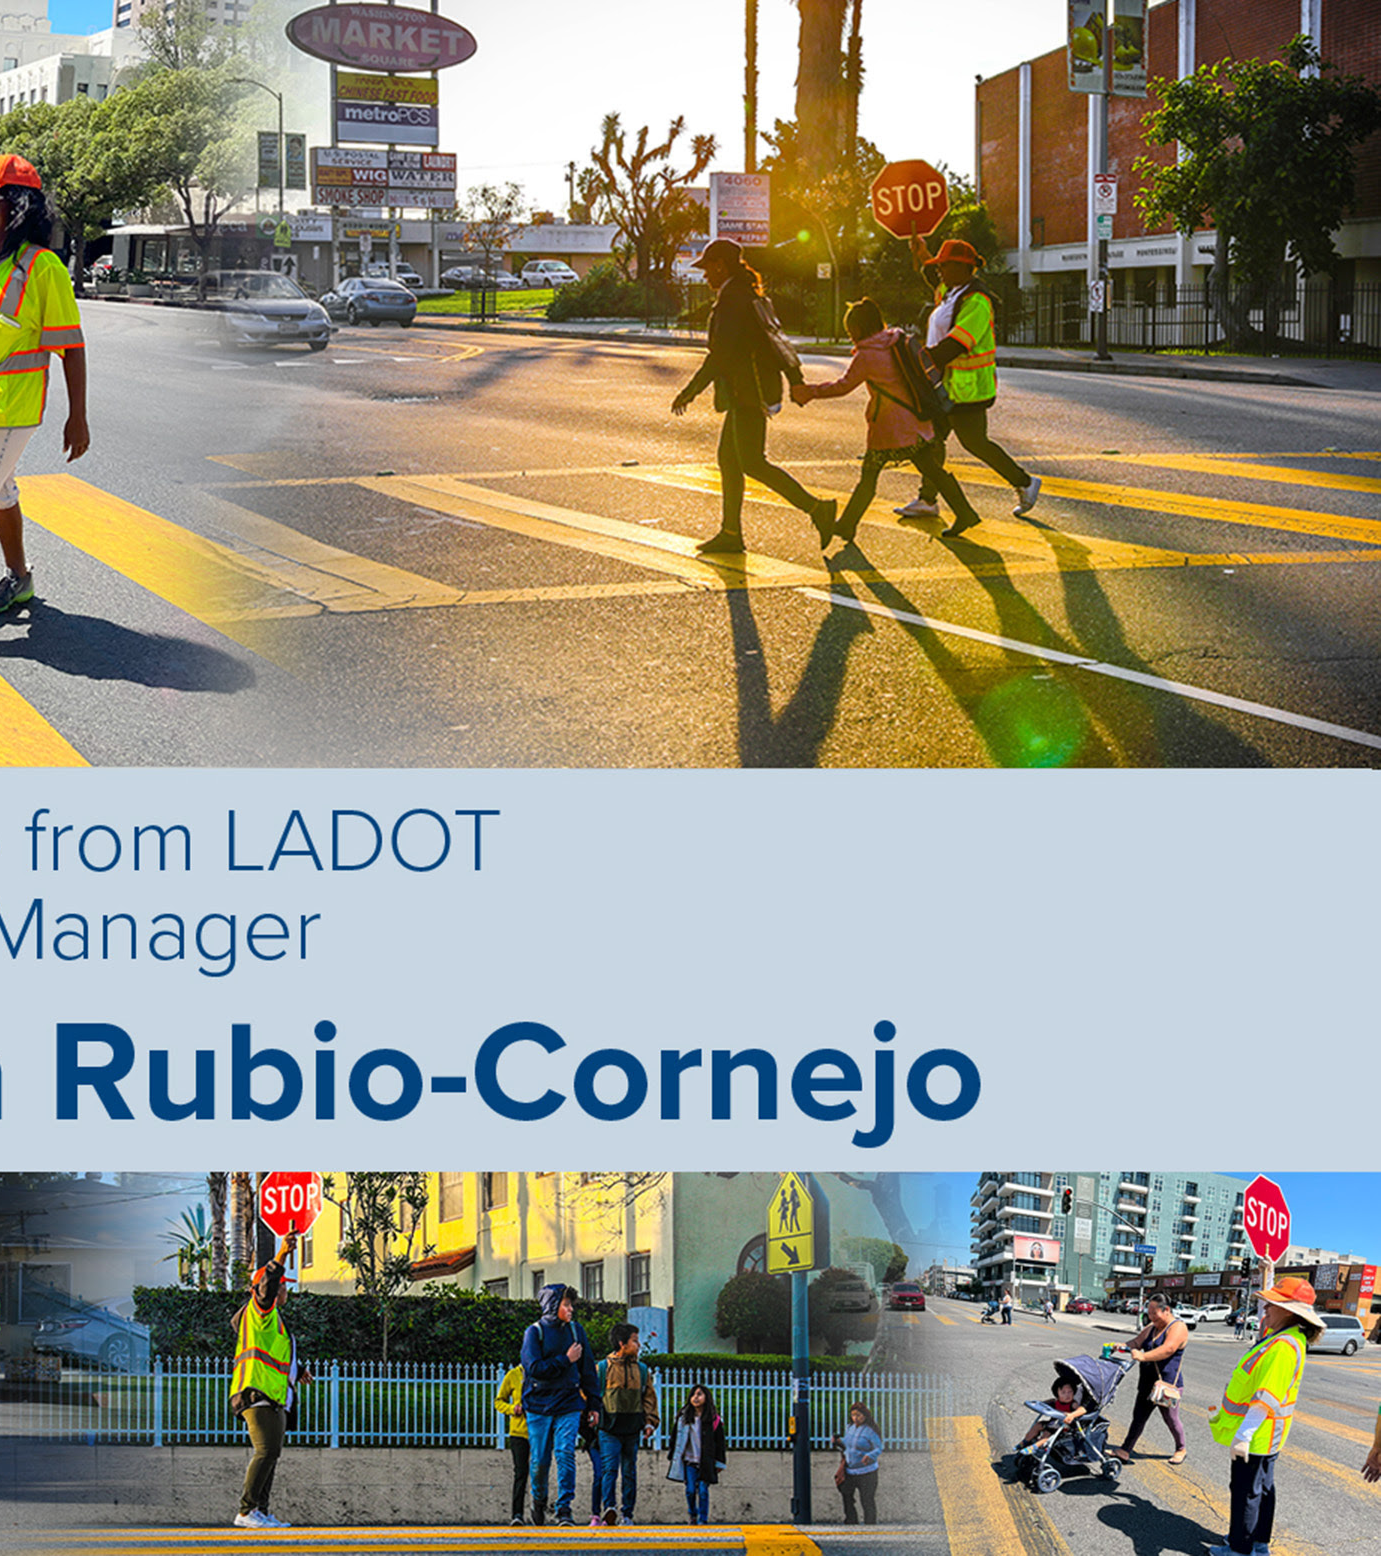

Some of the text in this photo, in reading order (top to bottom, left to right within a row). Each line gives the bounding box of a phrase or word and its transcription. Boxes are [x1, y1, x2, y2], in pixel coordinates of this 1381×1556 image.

[350, 6, 427, 23] WASHINGTON
[312, 15, 464, 57] MARKET
[361, 54, 415, 67] SQUARE
[338, 85, 437, 103] CHINESE FAST FOOD
[345, 106, 431, 125] metroPCS
[345, 151, 380, 159] POSTAL
[352, 168, 387, 181] WIG
[389, 170, 454, 182] WATER
[724, 175, 762, 187] 4060
[318, 187, 355, 204] SMOKE
[357, 189, 386, 205] SHOP
[877, 181, 942, 216] STOP
[264, 1184, 318, 1214] STOP
[1246, 1196, 1288, 1240] STOP
